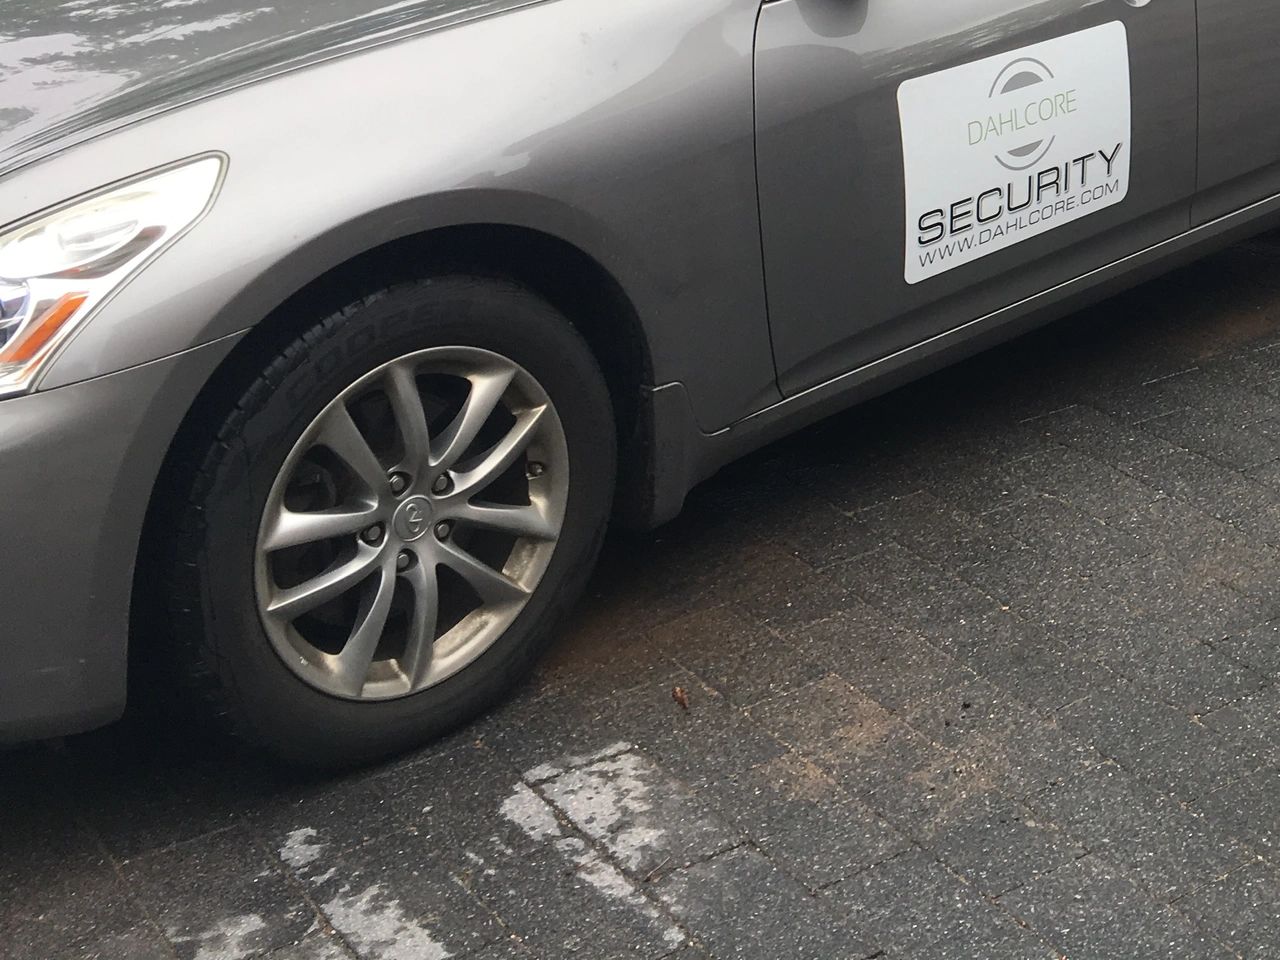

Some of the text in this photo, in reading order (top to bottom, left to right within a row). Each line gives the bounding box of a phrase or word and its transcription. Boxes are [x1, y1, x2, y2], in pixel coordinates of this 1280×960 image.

[967, 89, 1078, 146] DAHLCORE
[917, 142, 1123, 247] SECURITY
[918, 179, 1120, 268] WWW.DAHLCORE.COM
